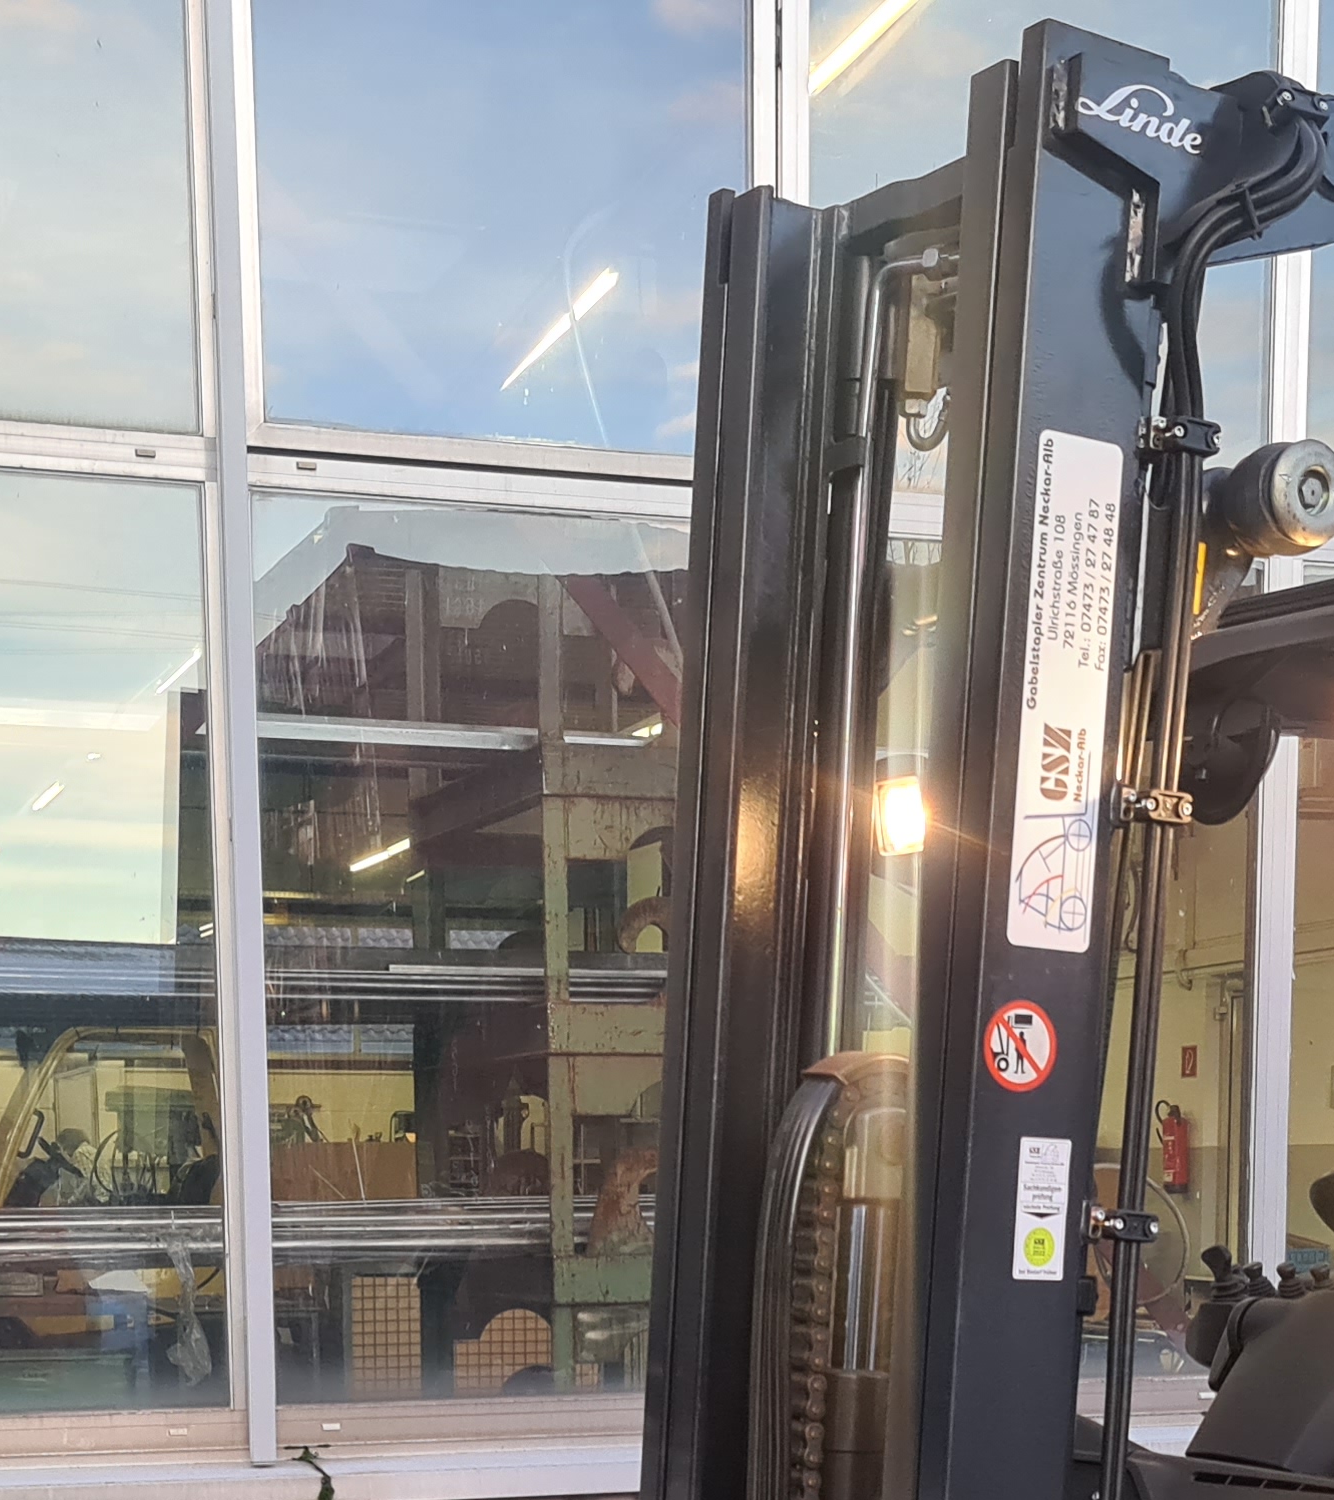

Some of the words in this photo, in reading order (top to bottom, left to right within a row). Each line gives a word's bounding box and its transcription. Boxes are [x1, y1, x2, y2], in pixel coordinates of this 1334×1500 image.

[1076, 84, 1202, 155] Linde
[1038, 437, 1055, 527] Neckar-Alb
[1054, 514, 1066, 543] 108
[1087, 522, 1099, 543] 47
[1088, 498, 1101, 518] 87
[1105, 502, 1117, 522] 48
[1067, 511, 1084, 596] Mössingen
[1085, 546, 1098, 566] 27
[1101, 549, 1113, 571] 27
[1103, 526, 1115, 546] 48
[1034, 532, 1049, 600] Zentrum
[1047, 549, 1064, 641] Ulrichstraße
[1080, 583, 1095, 633] 07473
[1096, 585, 1111, 636] 07473
[1063, 600, 1077, 649] 72116
[1026, 606, 1045, 710] Gabelstapler
[1094, 641, 1107, 672] Fax:
[1039, 722, 1073, 802] GSZ
[1073, 727, 1087, 804] Neckar-Alb
